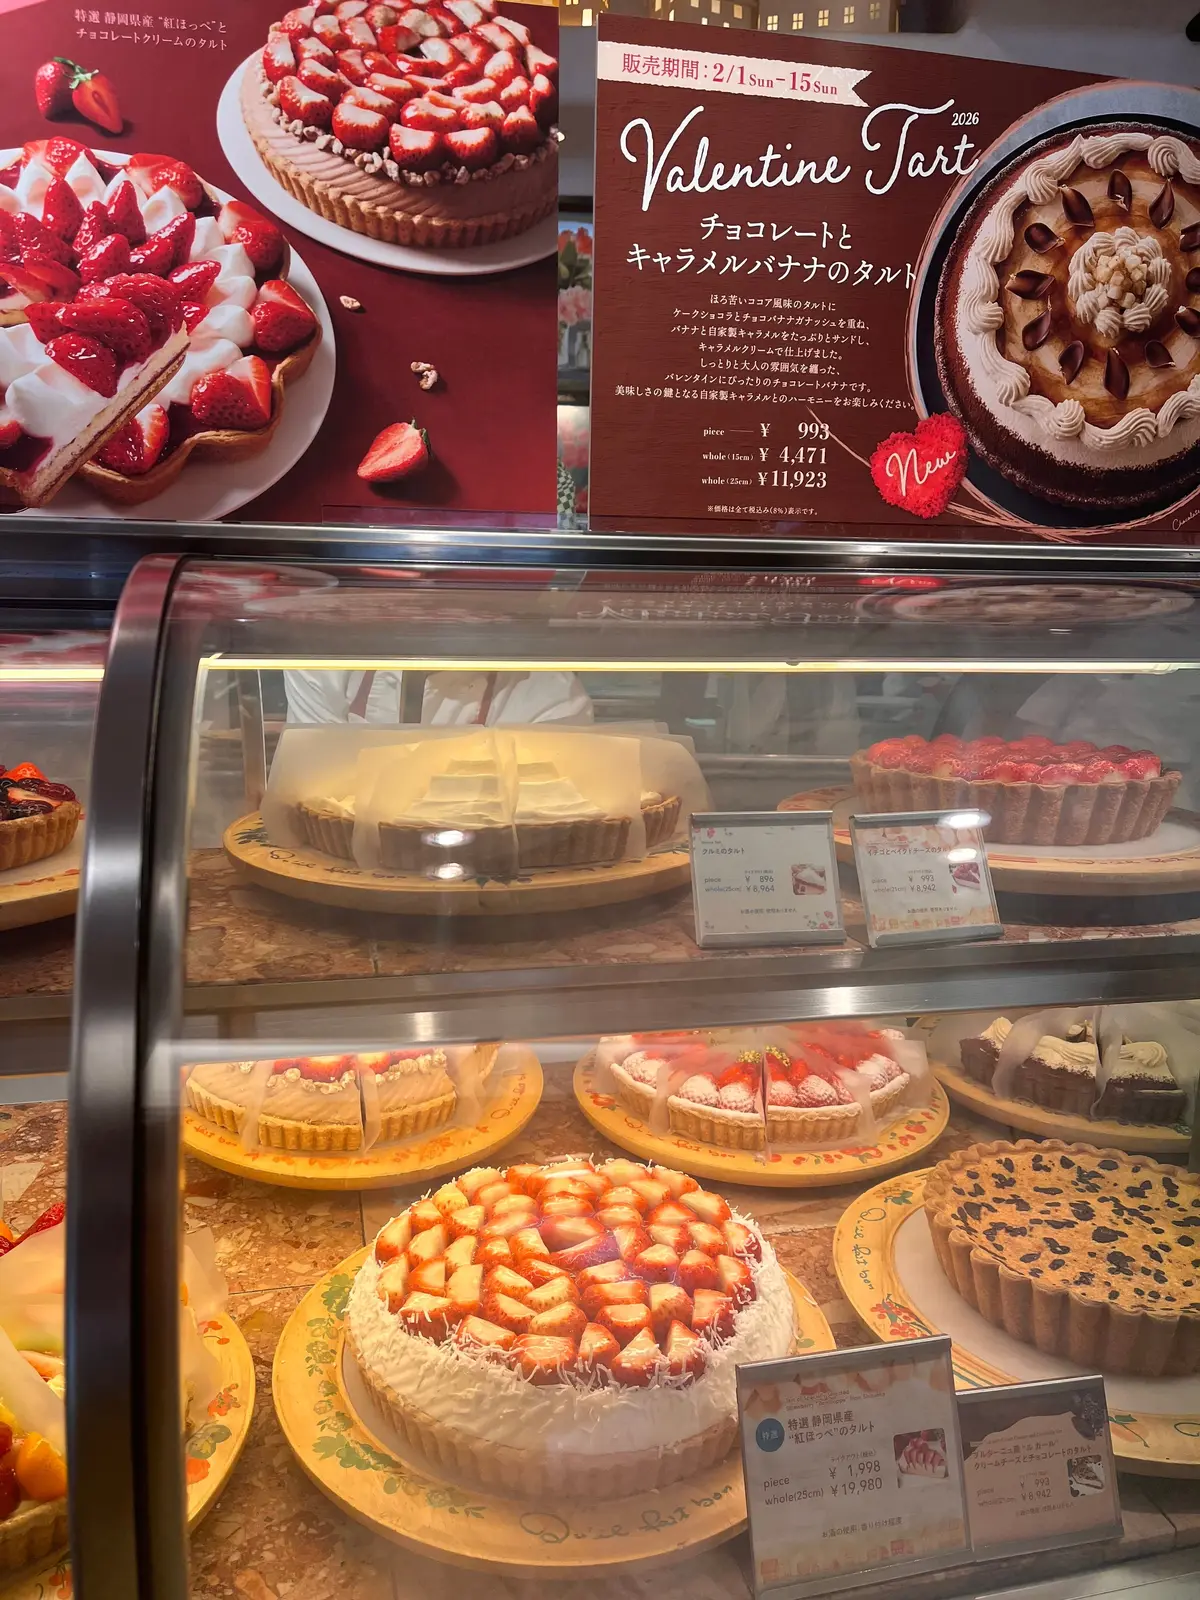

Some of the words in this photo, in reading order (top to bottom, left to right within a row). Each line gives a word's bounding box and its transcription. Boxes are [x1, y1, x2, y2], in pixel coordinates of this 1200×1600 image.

[74, 9, 101, 24] 特選
[76, 28, 228, 51] チョコレートクリームのタルト
[951, 112, 980, 127] 2026
[619, 105, 852, 212] Valentine
[861, 99, 981, 195] Tart
[700, 213, 854, 251] チョコレートと
[626, 243, 917, 290] キャラメルバナナのタルト
[709, 294, 837, 312] ほろ苦いココア風味のタルトに
[703, 427, 725, 437] piece
[798, 422, 830, 440] 993
[779, 445, 827, 466] 4,471
[886, 448, 957, 497] New
[759, 874, 774, 884] 896
[920, 874, 935, 884] 993
[788, 1416, 809, 1431] 特選
[812, 1410, 854, 1428] 静岡県産
[763, 1477, 790, 1491] piece
[847, 1459, 881, 1478] 1,998
